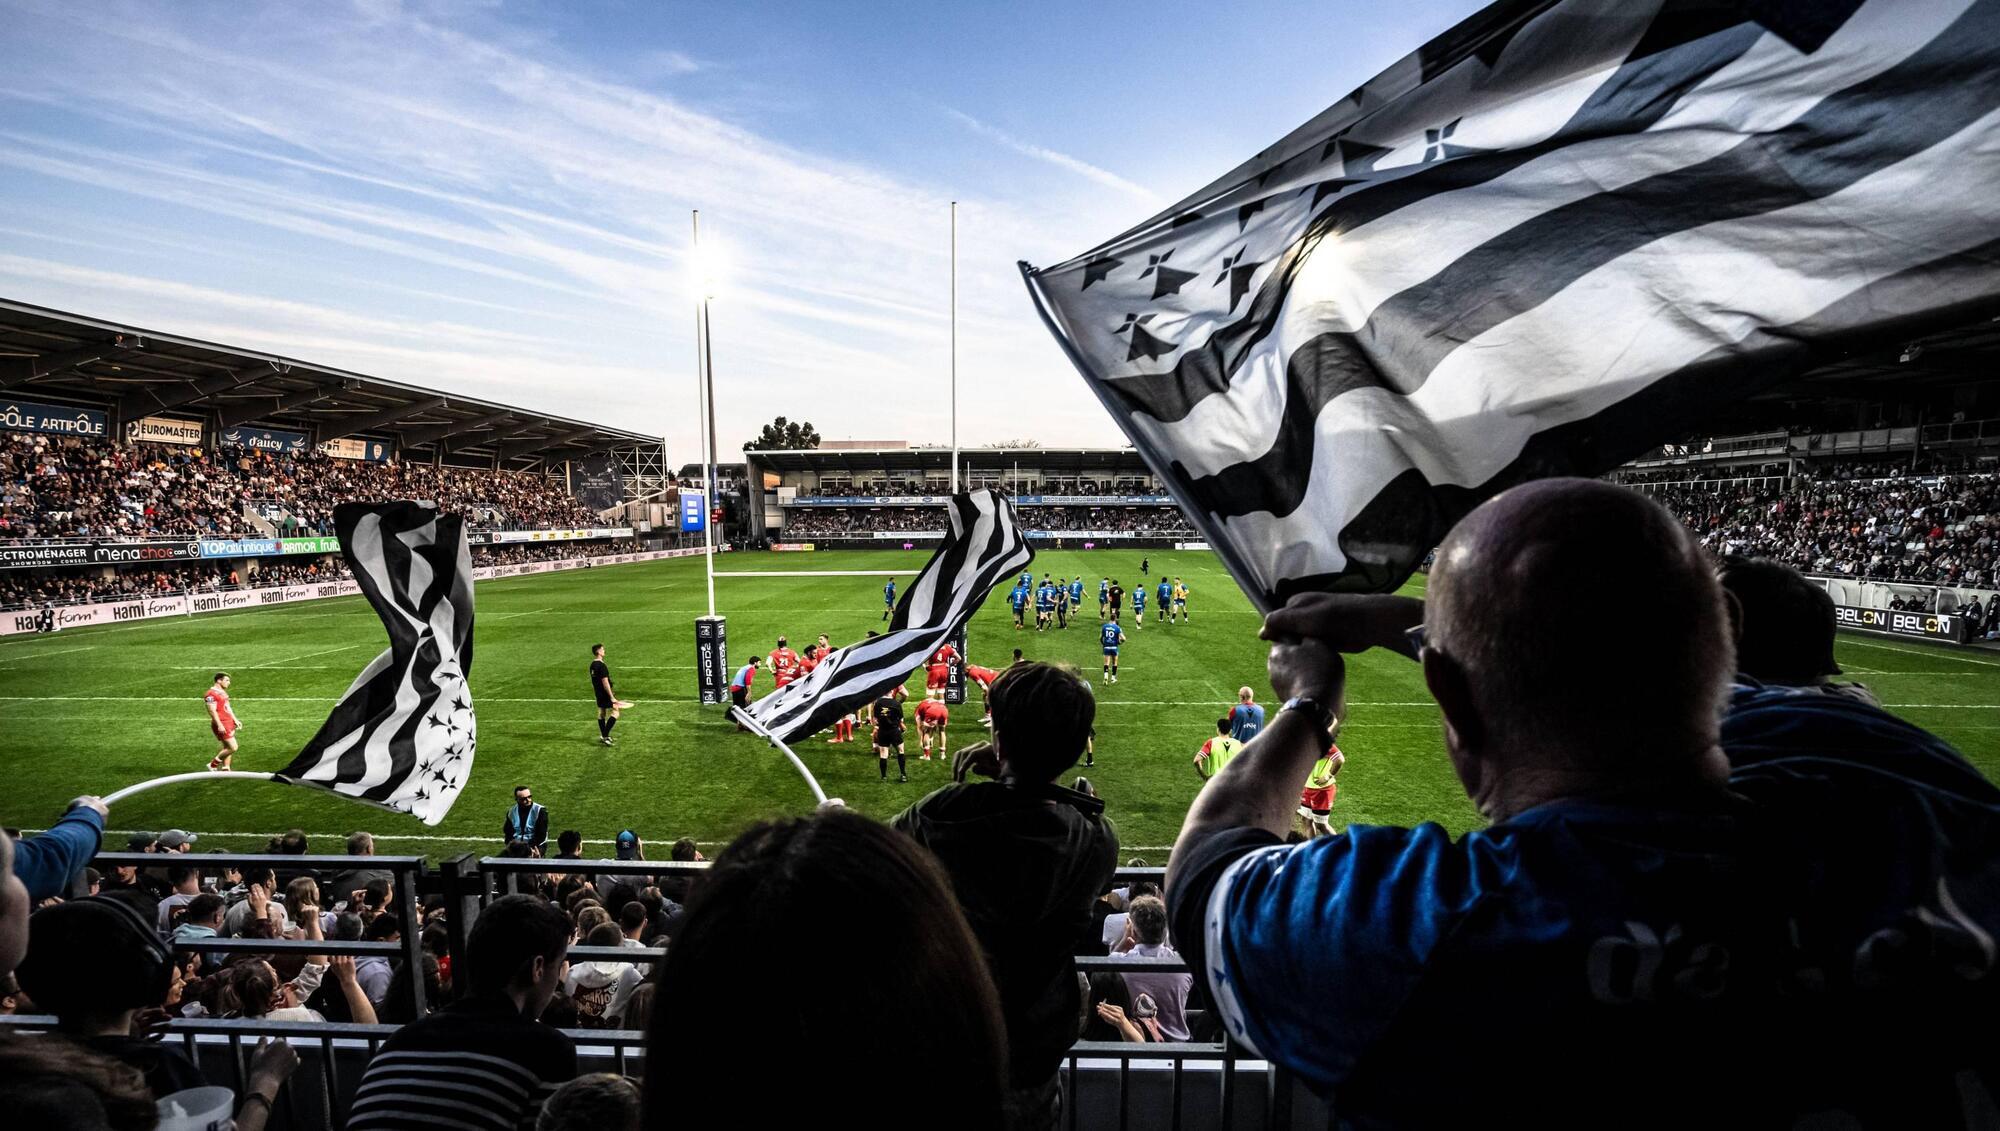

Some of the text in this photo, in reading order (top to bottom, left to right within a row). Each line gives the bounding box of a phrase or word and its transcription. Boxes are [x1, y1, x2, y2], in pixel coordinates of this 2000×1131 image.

[41, 413, 103, 434] ARTIPÔLE
[141, 424, 200, 439] EUROMASTER
[249, 436, 283, 451] d'aucy
[284, 541, 316, 553] ARMOR
[261, 588, 306, 603] Hami form
[318, 582, 357, 597] Hami form
[194, 593, 246, 611] Hami form
[57, 609, 91, 626] form
[113, 601, 176, 620] Hami form
[1105, 630, 1115, 638] 10
